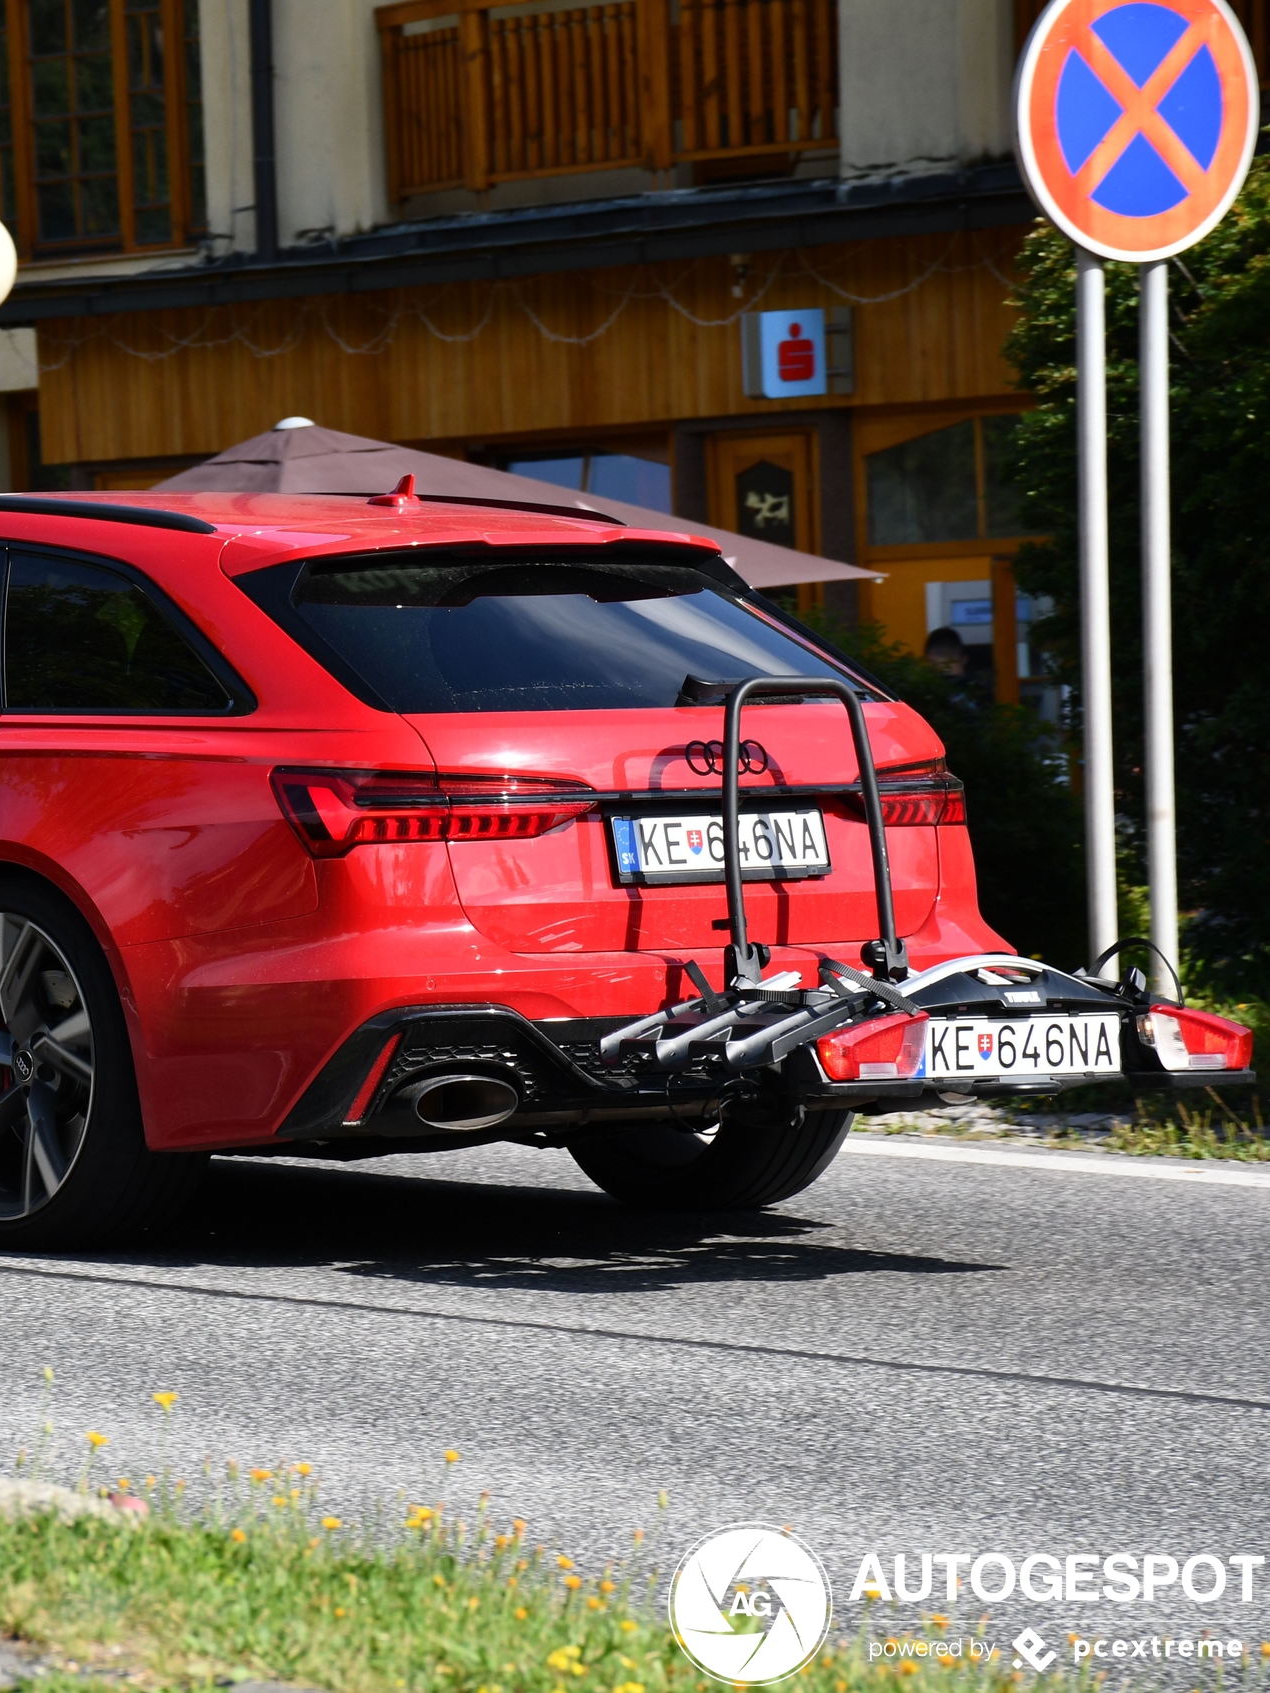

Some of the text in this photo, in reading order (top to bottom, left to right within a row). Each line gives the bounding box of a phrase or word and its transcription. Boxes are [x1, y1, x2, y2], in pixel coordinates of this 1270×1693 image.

[621, 851, 636, 865] SK
[638, 822, 687, 866] KE
[932, 1022, 1113, 1071] KE 646NA
